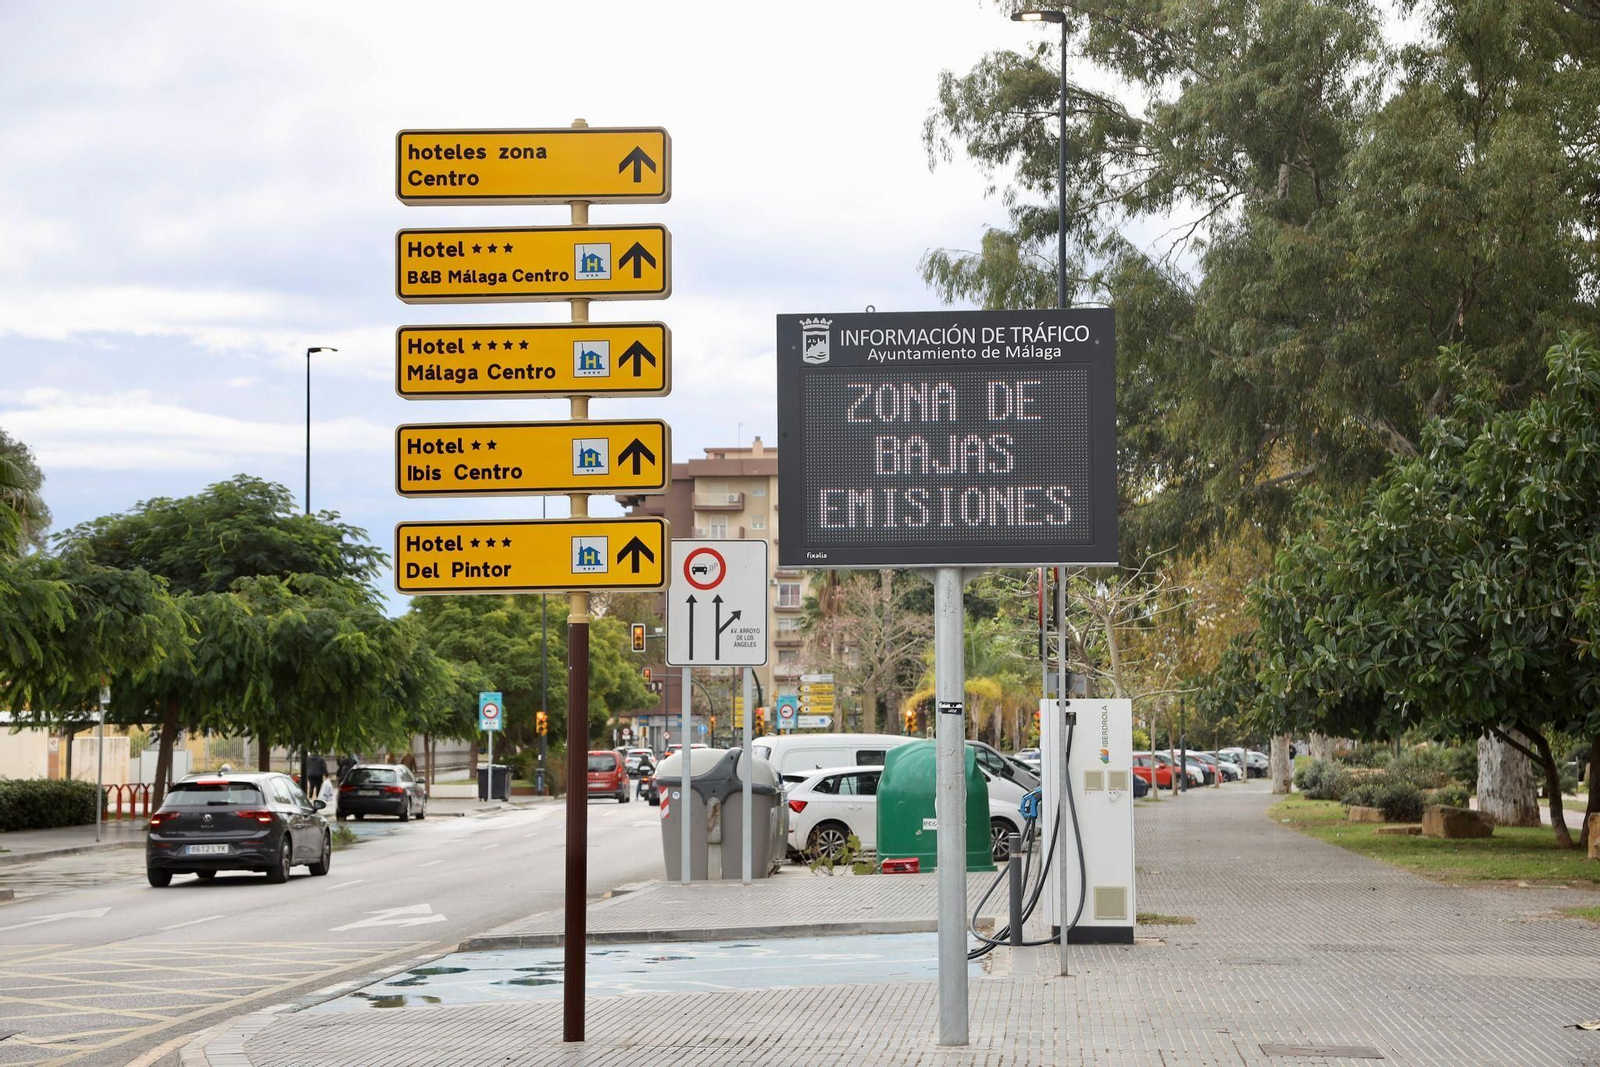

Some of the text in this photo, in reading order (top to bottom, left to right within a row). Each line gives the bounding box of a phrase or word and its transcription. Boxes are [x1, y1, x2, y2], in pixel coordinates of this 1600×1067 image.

[408, 143, 548, 160] hoteles zona
[407, 169, 480, 187] Centro
[407, 240, 465, 258] Hotel
[407, 268, 569, 286] B&B Málaga Centro
[840, 321, 1091, 347] INFORMACIÓN DE TRÁFICO
[407, 337, 465, 355] Hotel
[866, 344, 1062, 363] Ayuntamiento de Málaga
[407, 363, 556, 383] Málaga Centro
[847, 379, 1043, 423] ZONA DE
[406, 437, 464, 455] Hotel
[875, 434, 1014, 476] BAJAS
[406, 463, 523, 482] Ibis Centro
[819, 485, 1072, 529] EMISIONES
[406, 535, 464, 553] Hotel
[406, 561, 512, 579] Del Pintor
[1101, 704, 1109, 747] IBERDROLA
